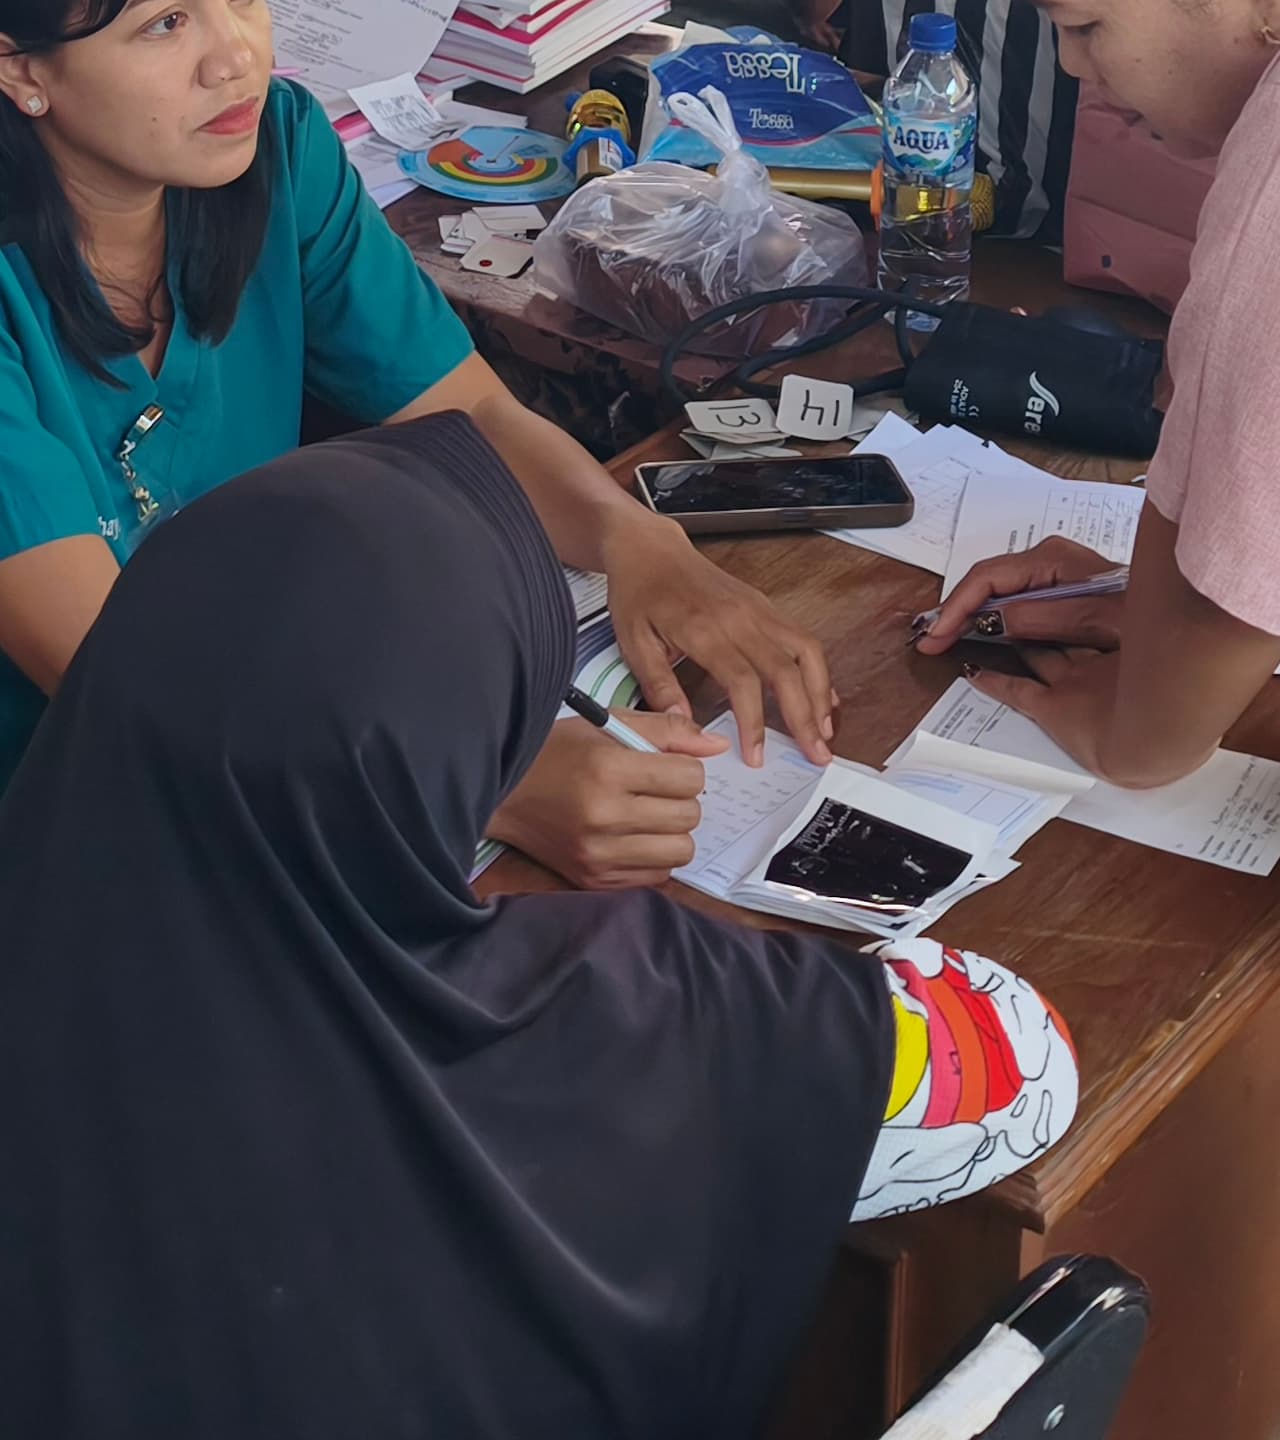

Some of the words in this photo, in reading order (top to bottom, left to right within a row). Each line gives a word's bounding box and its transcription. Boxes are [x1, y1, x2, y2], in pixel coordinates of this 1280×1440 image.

[722, 51, 806, 95] Tessa
[748, 107, 794, 129] Tessa
[893, 125, 950, 154] AQUA
